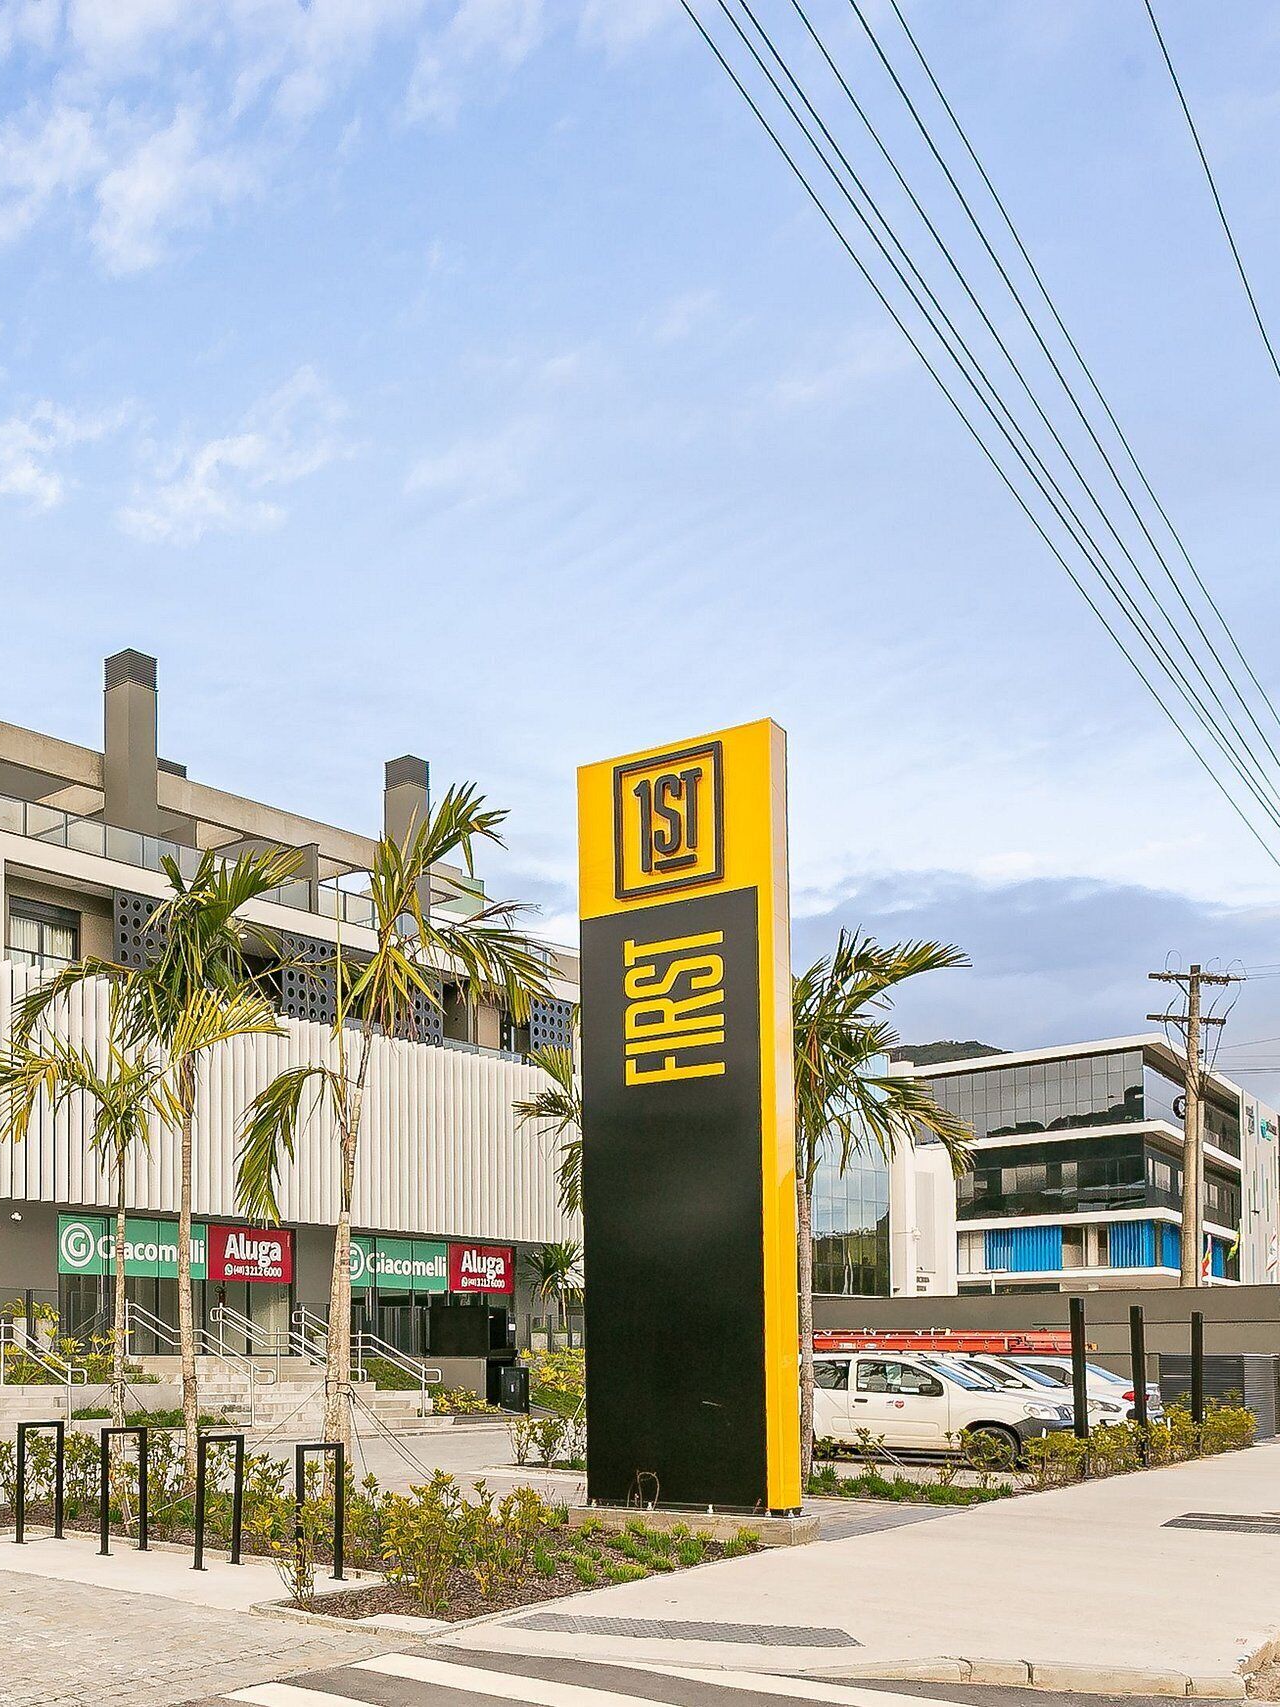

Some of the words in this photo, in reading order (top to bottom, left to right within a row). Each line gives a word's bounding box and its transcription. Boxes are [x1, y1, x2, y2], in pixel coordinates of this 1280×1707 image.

[633, 767, 703, 873] 1ST
[623, 930, 726, 1087] FIRST
[97, 1234, 206, 1264] Gacomlli
[224, 1233, 282, 1267] Aluga
[366, 1251, 447, 1277] Giacomelli
[461, 1249, 505, 1280] Aluga
